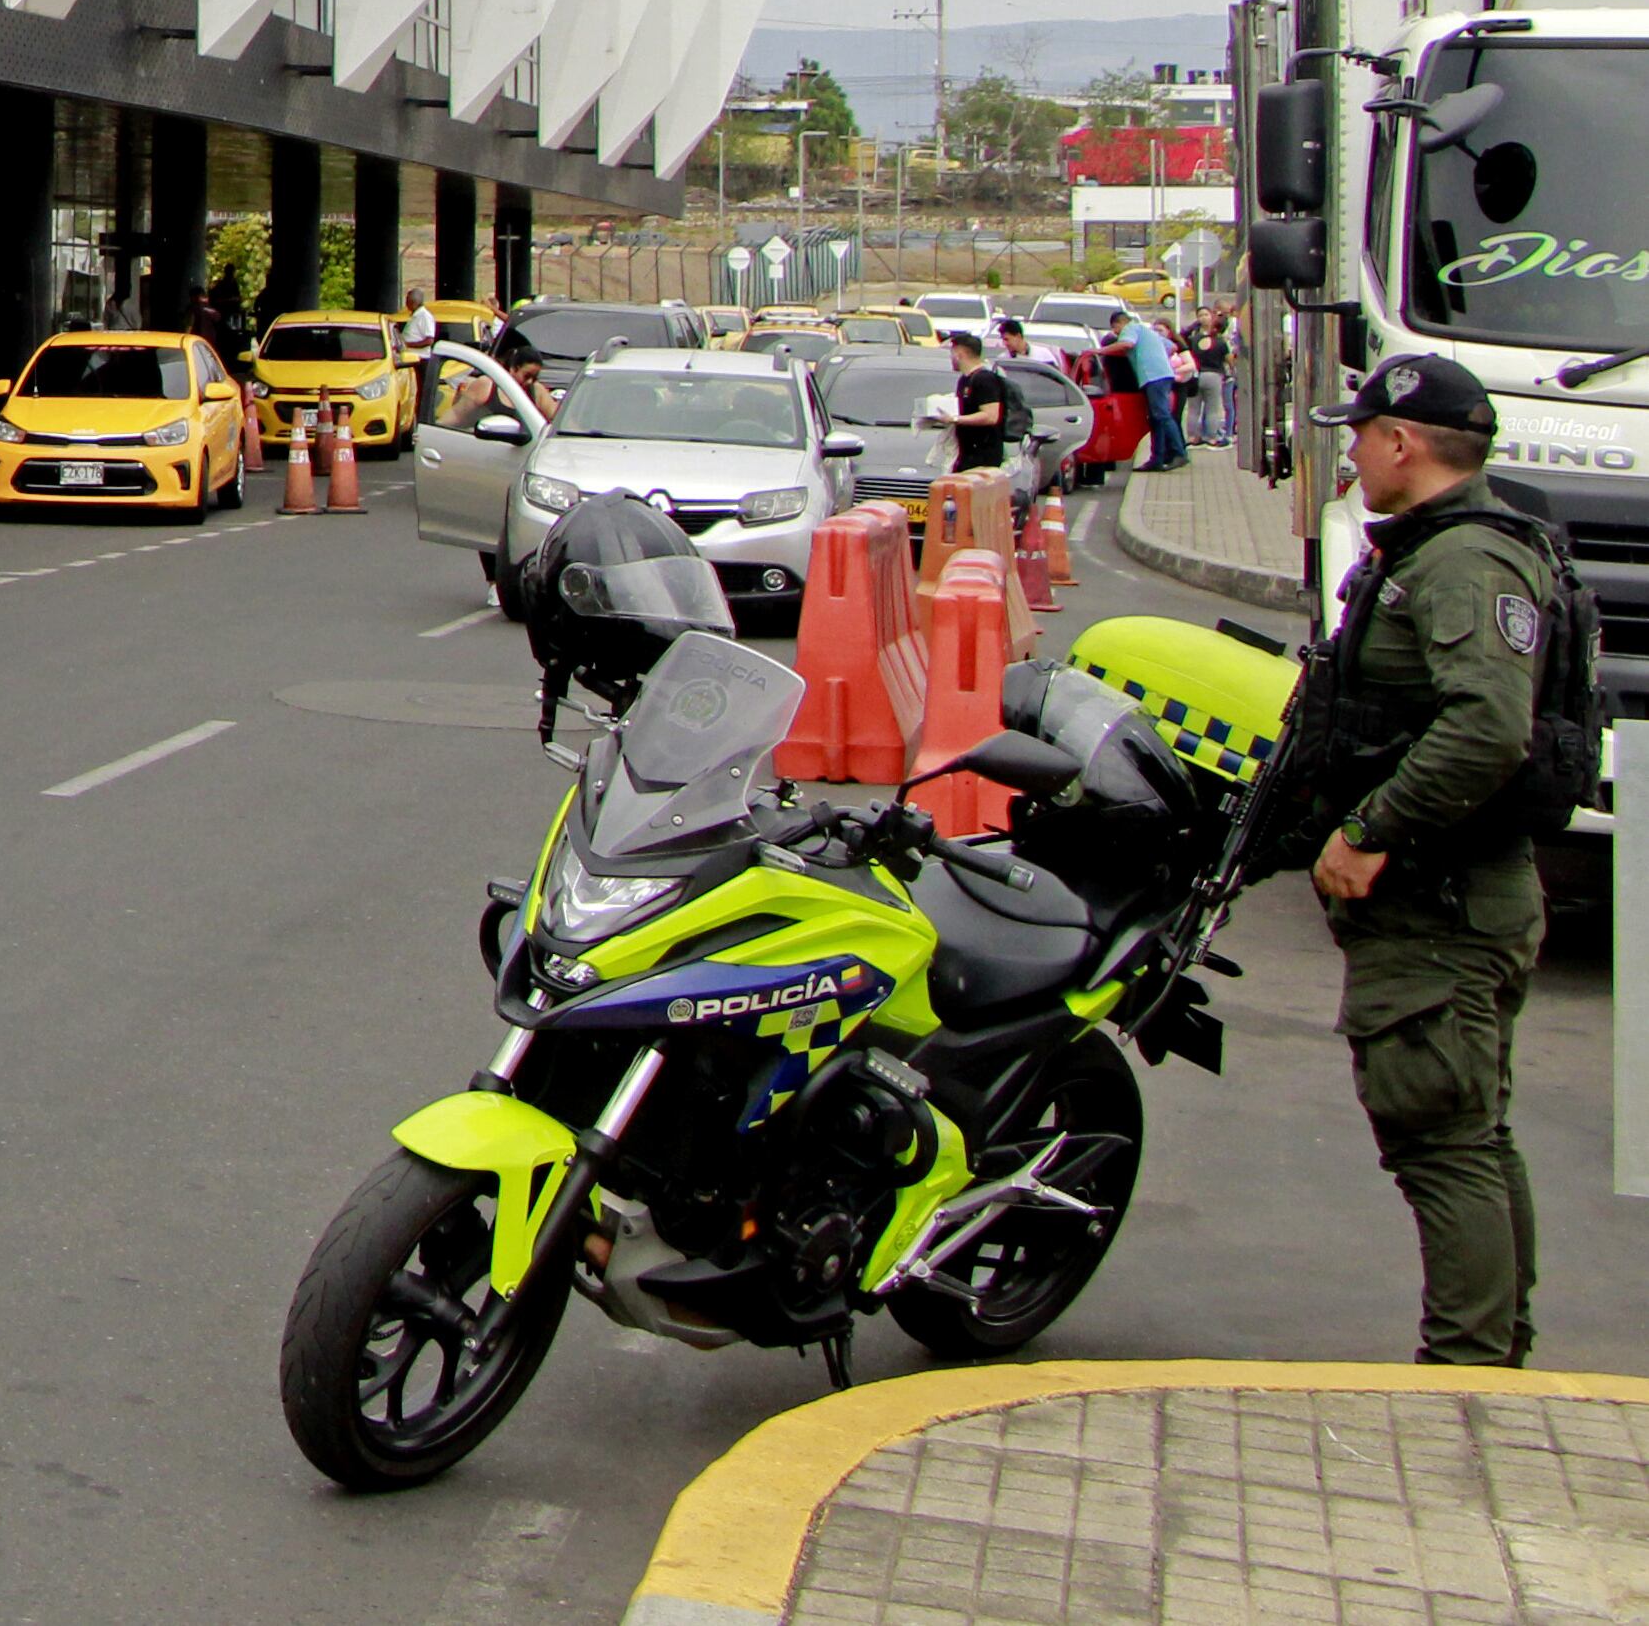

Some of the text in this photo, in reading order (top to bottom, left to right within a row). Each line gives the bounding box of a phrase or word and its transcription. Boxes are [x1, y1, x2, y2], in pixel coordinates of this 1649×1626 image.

[1499, 416, 1619, 441] racoDidacol
[1488, 440, 1635, 470] HINO
[685, 648, 767, 691] POLICÍA
[696, 974, 838, 1020] POLICÍA
